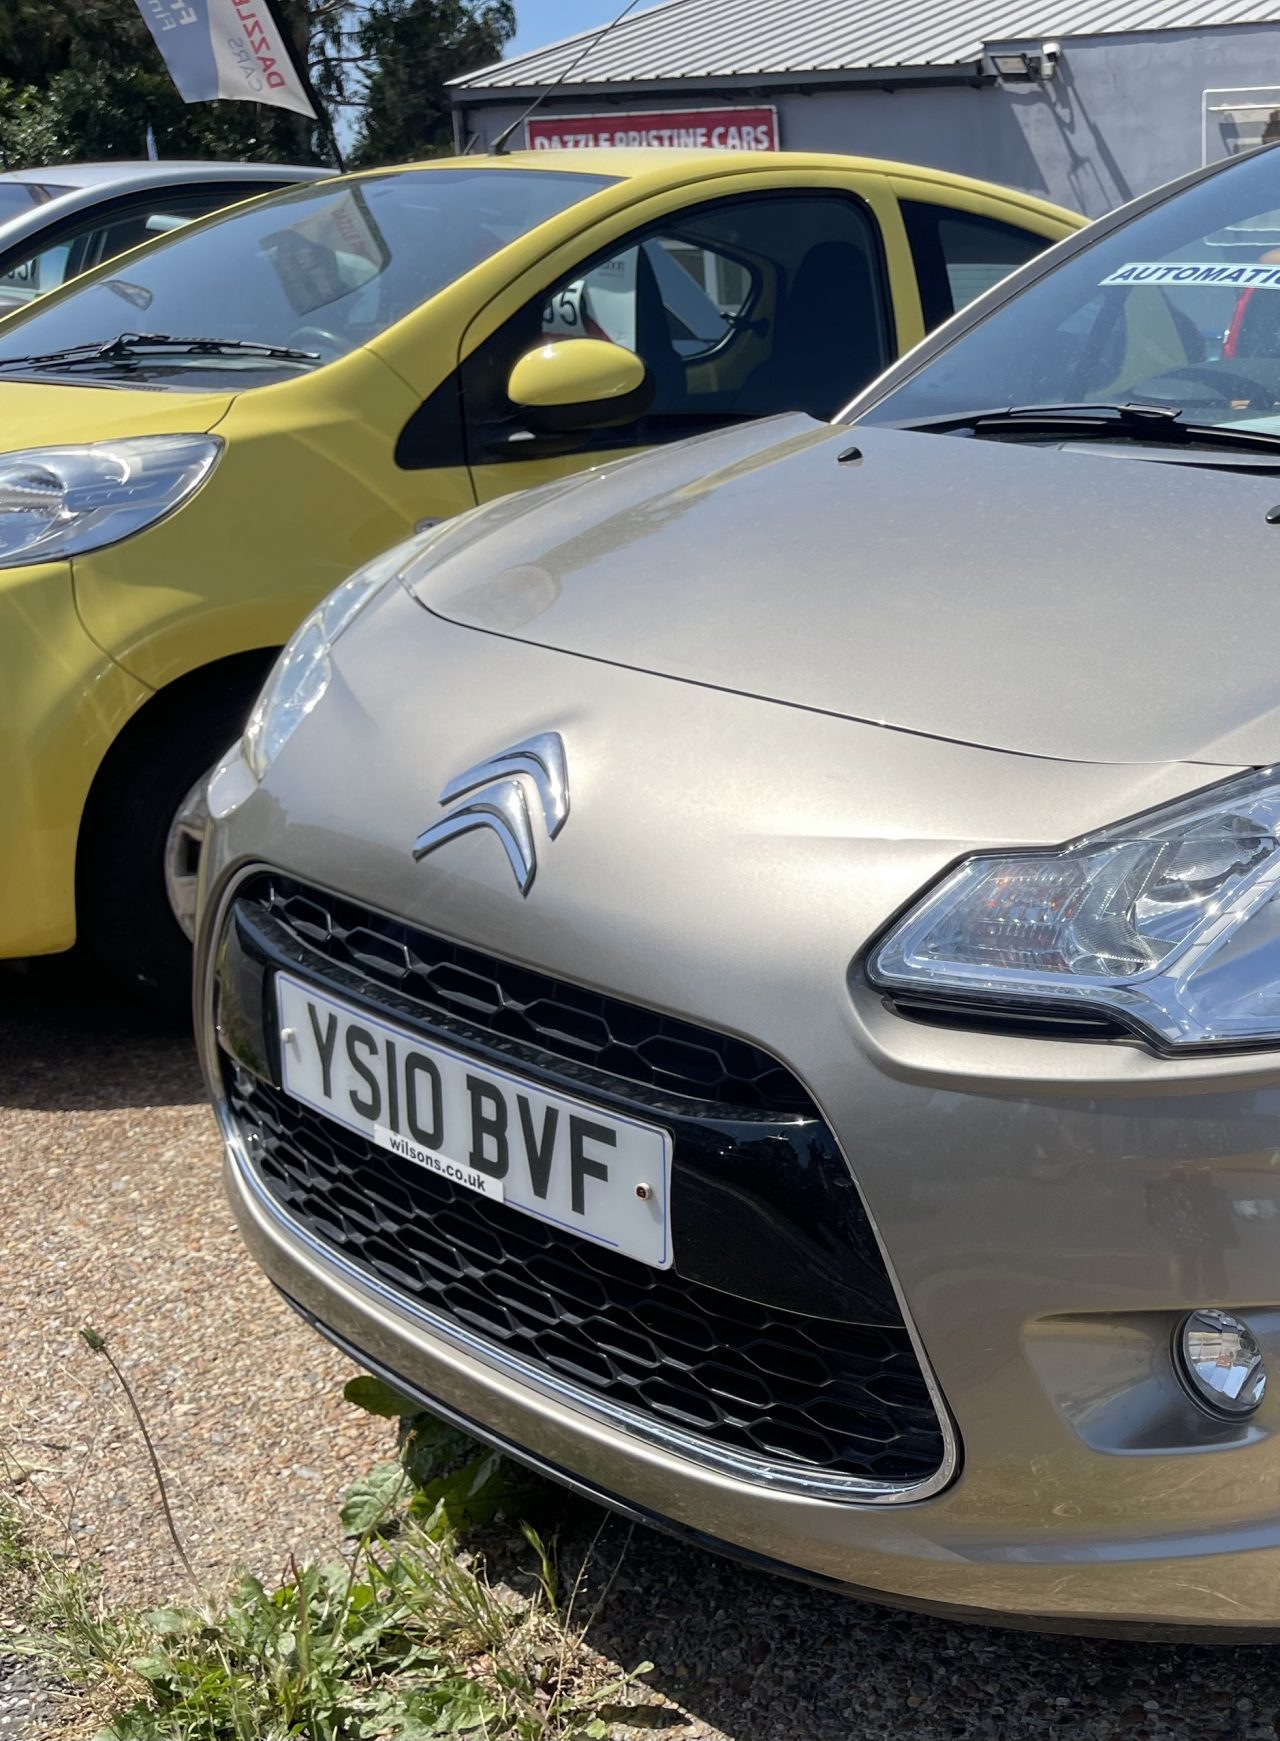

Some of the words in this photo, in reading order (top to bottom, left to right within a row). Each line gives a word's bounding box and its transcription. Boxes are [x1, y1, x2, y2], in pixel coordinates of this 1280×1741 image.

[711, 125, 770, 150] CARS
[389, 1137, 486, 1192] wilsons.co.uk
[466, 1073, 617, 1217] BVF
